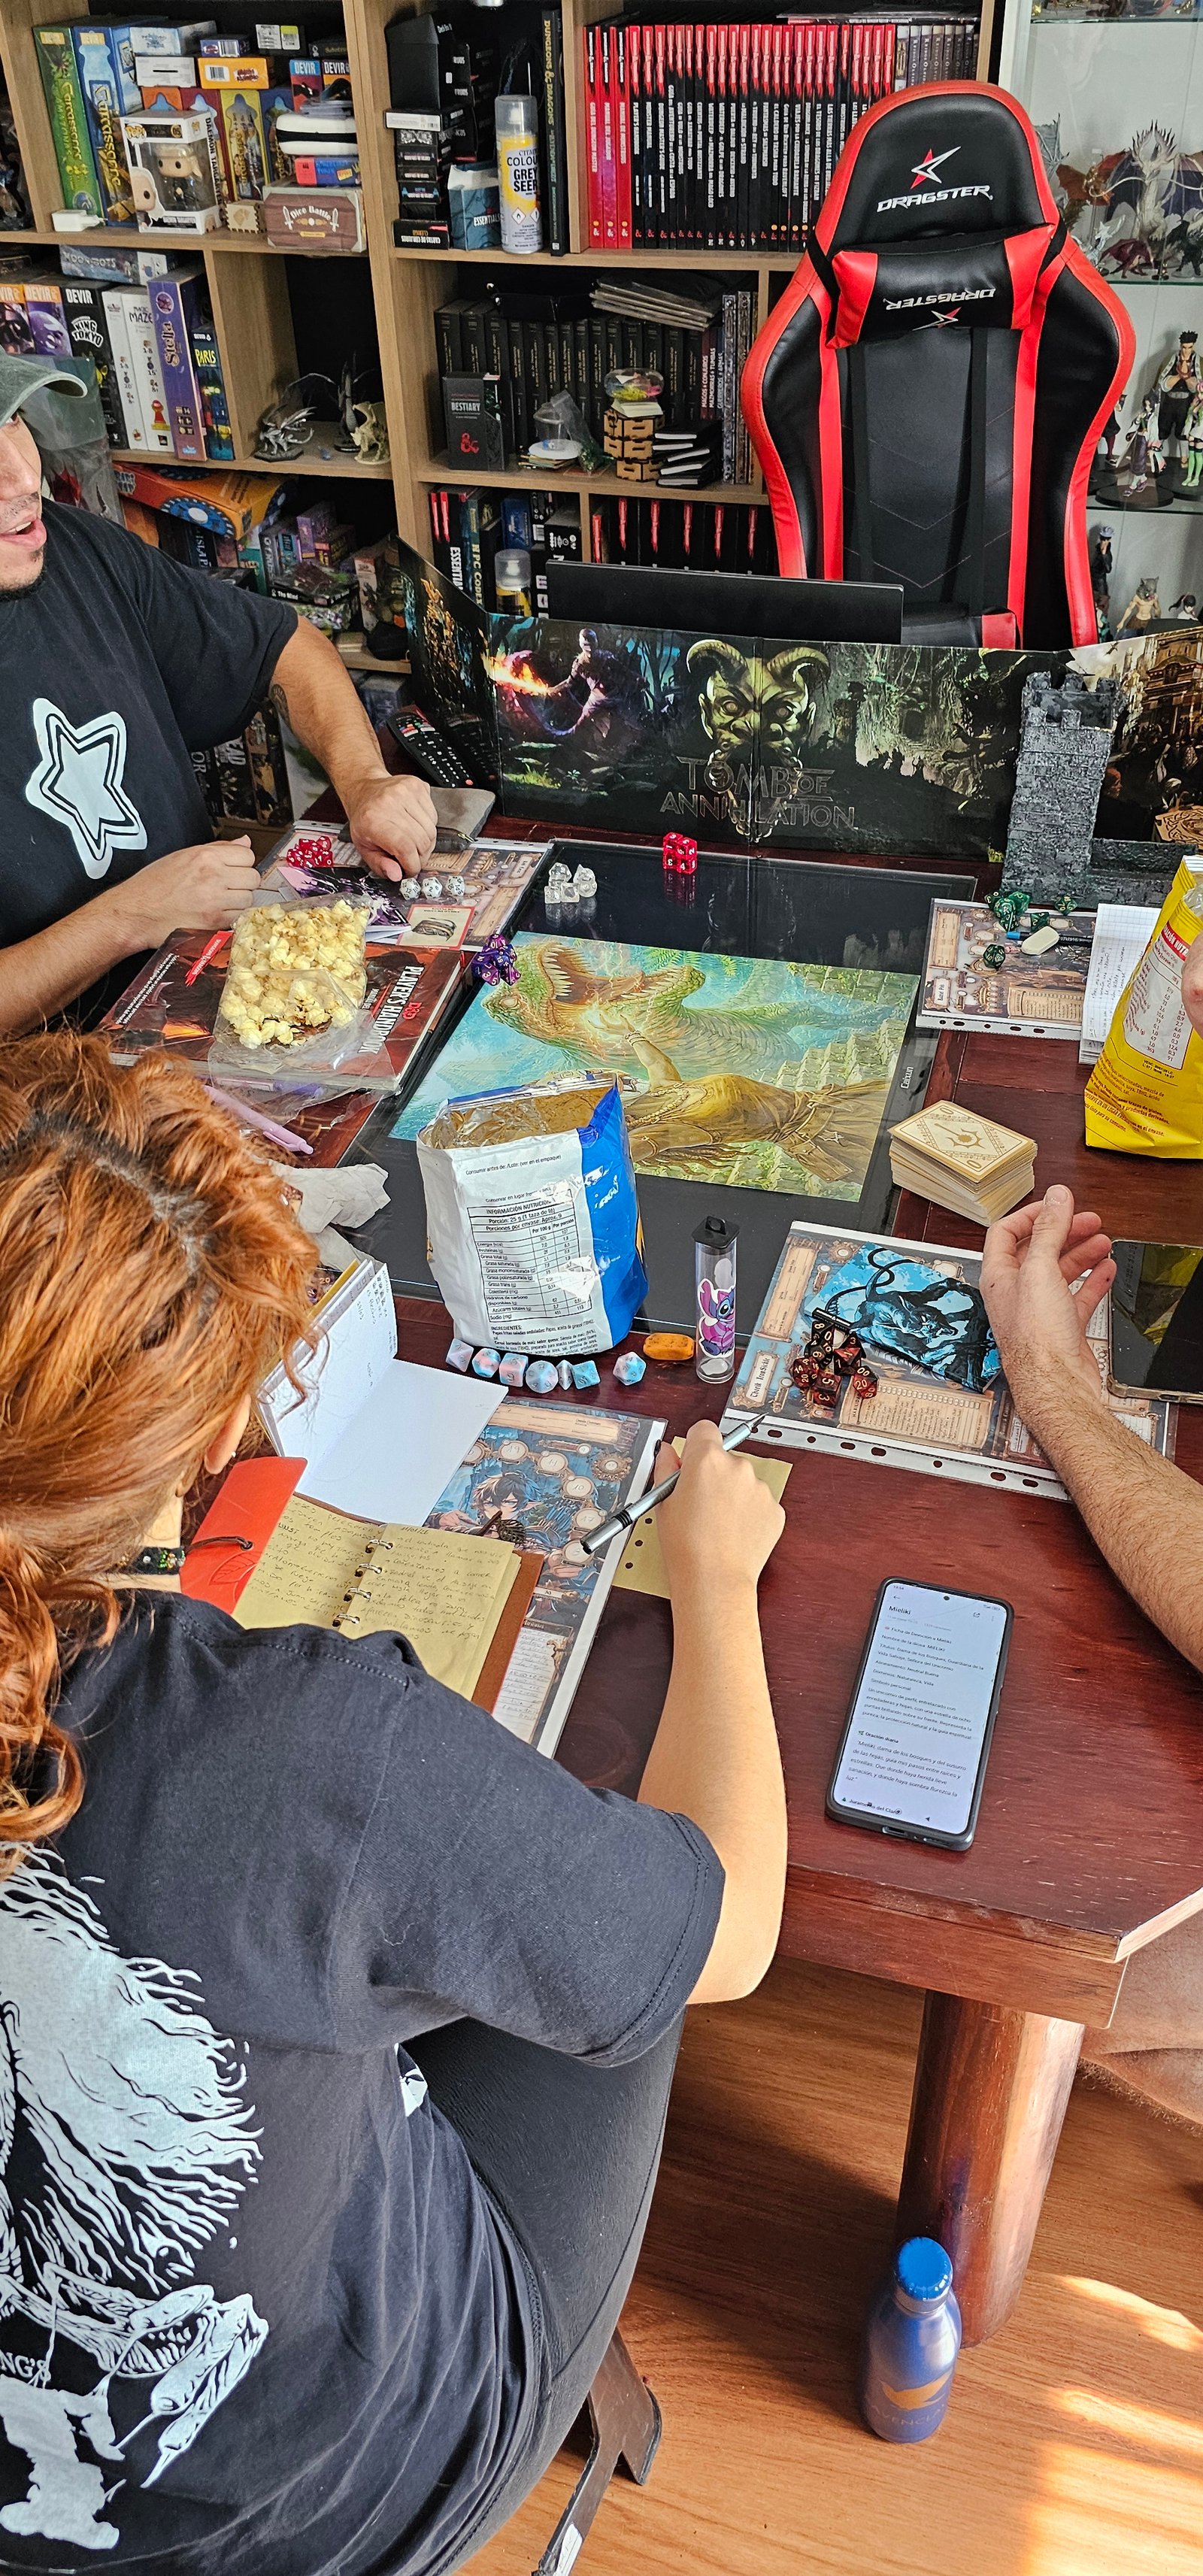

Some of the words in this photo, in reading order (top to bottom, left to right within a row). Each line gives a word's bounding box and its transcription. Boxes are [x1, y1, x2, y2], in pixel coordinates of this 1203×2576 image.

[544, 20, 553, 69] DUNGEONS
[294, 62, 316, 74] DEVIR
[323, 62, 346, 74] DEVIR
[545, 83, 554, 126] DRAGONS
[61, 82, 82, 160] Carcassonne
[95, 86, 121, 186] Carcassonne
[205, 117, 216, 154] DAEMON
[507, 156, 538, 166] COLOU
[514, 168, 538, 180] GREY
[877, 184, 994, 213] DRAGSTER
[289, 208, 307, 220] Dice
[308, 205, 332, 220] Battle
[26, 287, 50, 301] DEVIR
[65, 288, 93, 305] DEVIR
[883, 287, 996, 311] DRAGSTER
[75, 320, 96, 332] KING
[129, 312, 153, 324] MAZE
[73, 330, 102, 347] TOKYO
[162, 321, 180, 367] Stella
[195, 349, 217, 368] PARIS
[451, 402, 480, 411] BESTIARY
[471, 544, 481, 569] NPC
[277, 590, 286, 599] The
[286, 592, 298, 601] Mind
[474, 571, 483, 605] CODEX
[676, 756, 792, 799] TOMB
[659, 791, 855, 828] ANNIHILATION
[386, 965, 425, 1005] PLAYER'S
[357, 1005, 402, 1054] HANDBOOK
[899, 1065, 914, 1090] Caixun
[540, 1154, 562, 1163] empaque)
[486, 1205, 523, 1215] INFORMACIÓN
[889, 1605, 911, 1615] Mieliki
